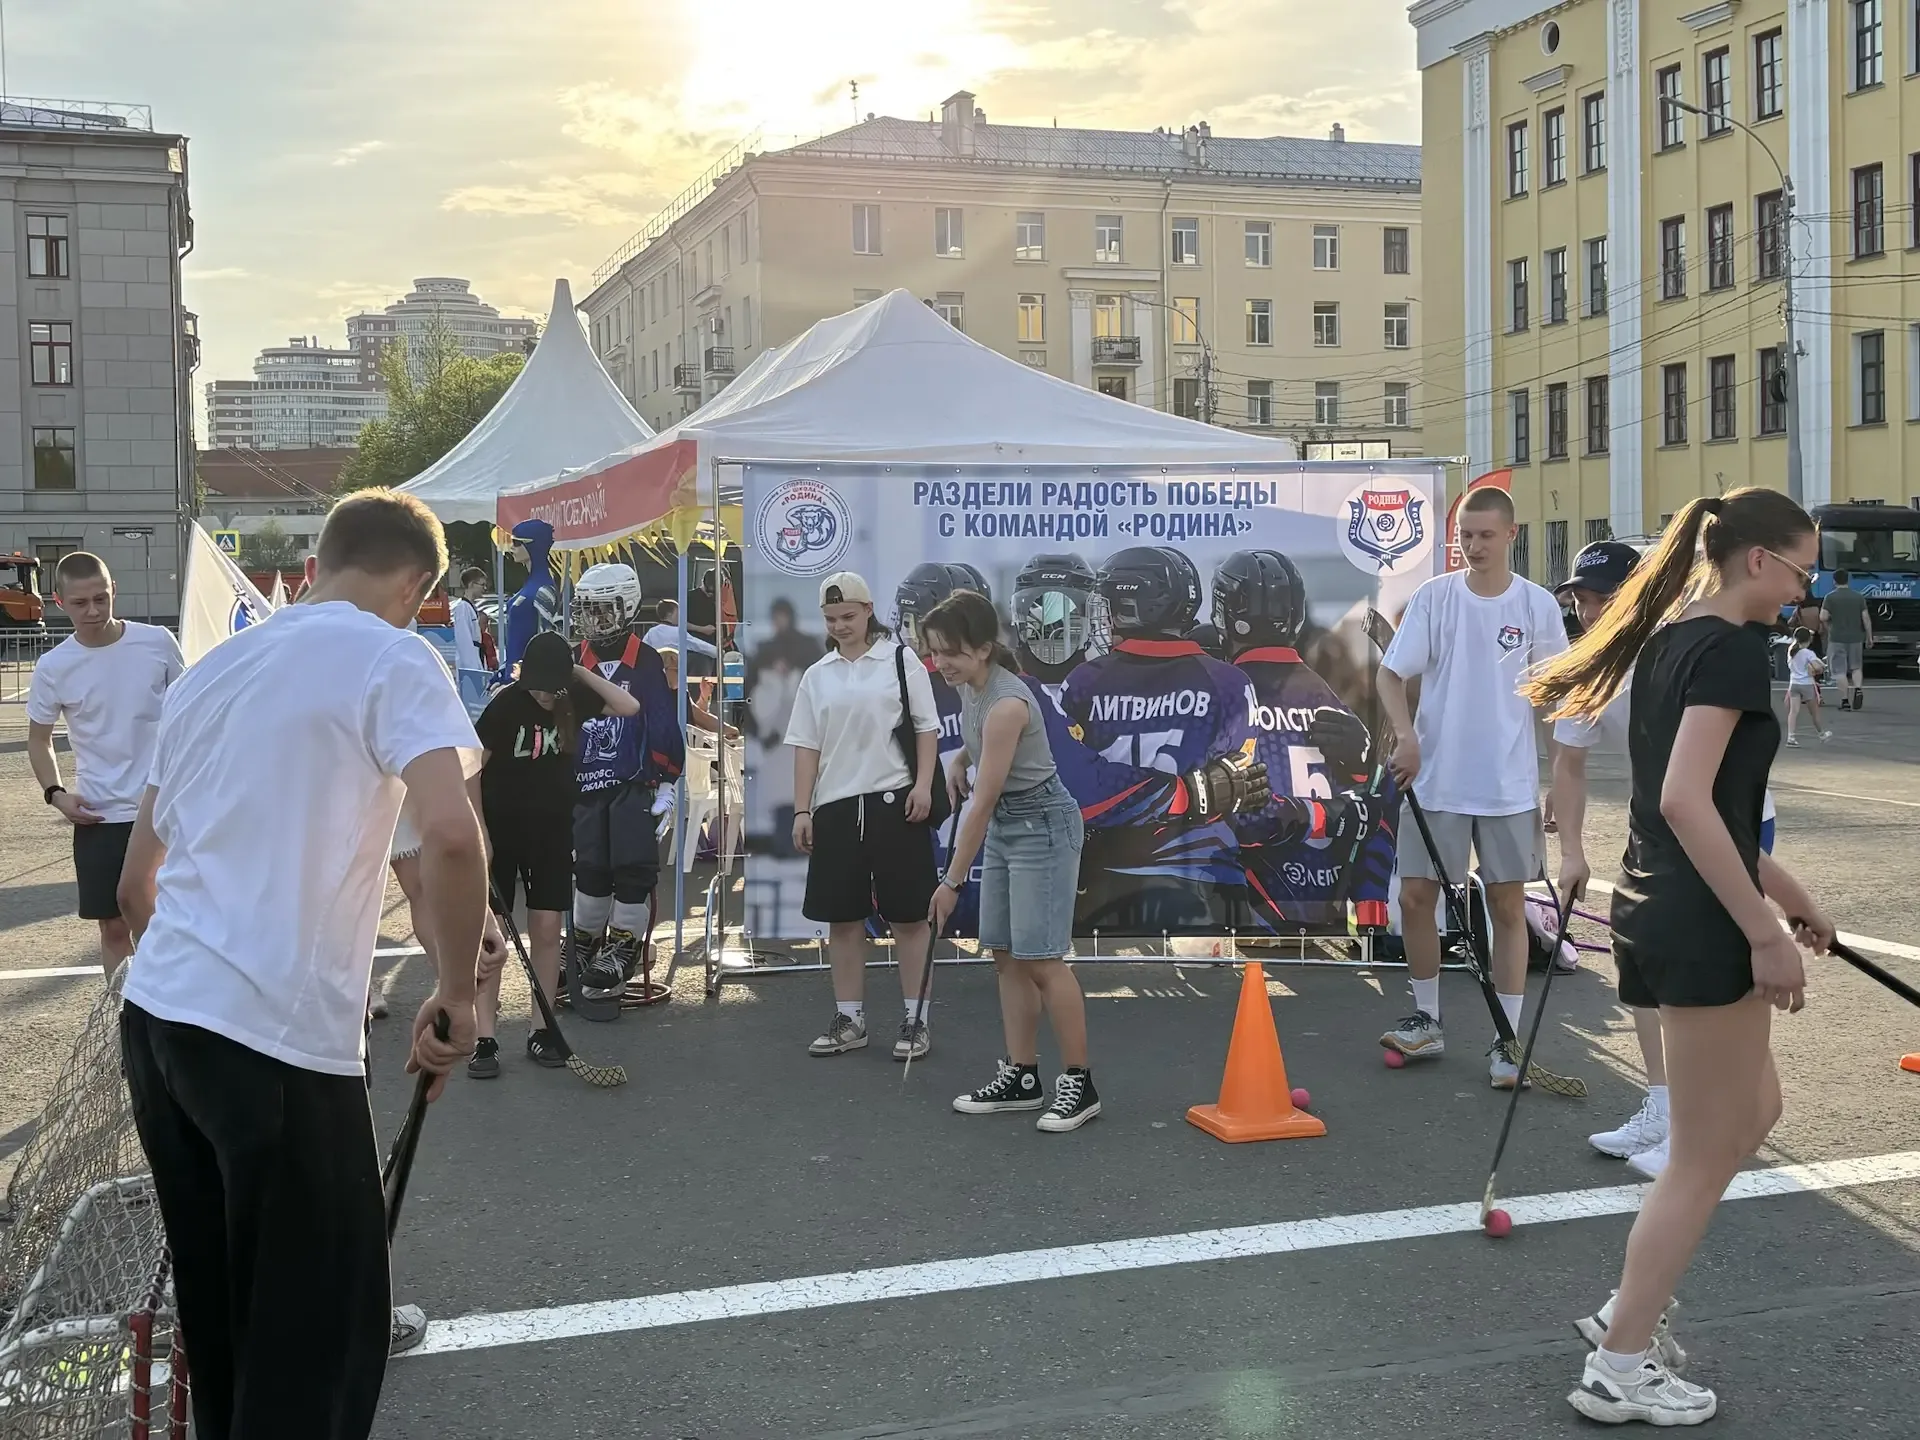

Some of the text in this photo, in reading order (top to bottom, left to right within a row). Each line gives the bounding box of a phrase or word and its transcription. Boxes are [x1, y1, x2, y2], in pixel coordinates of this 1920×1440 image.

[913, 481, 1277, 510] РАЗДЕЛИ РАДОСТЬ ПОБЕДЫ
[1367, 494, 1404, 507] РОДИНА
[939, 508, 1252, 542] С КОМАНДОЙ «РОДИНА»
[1088, 689, 1211, 722] ЛИТВИНОВ
